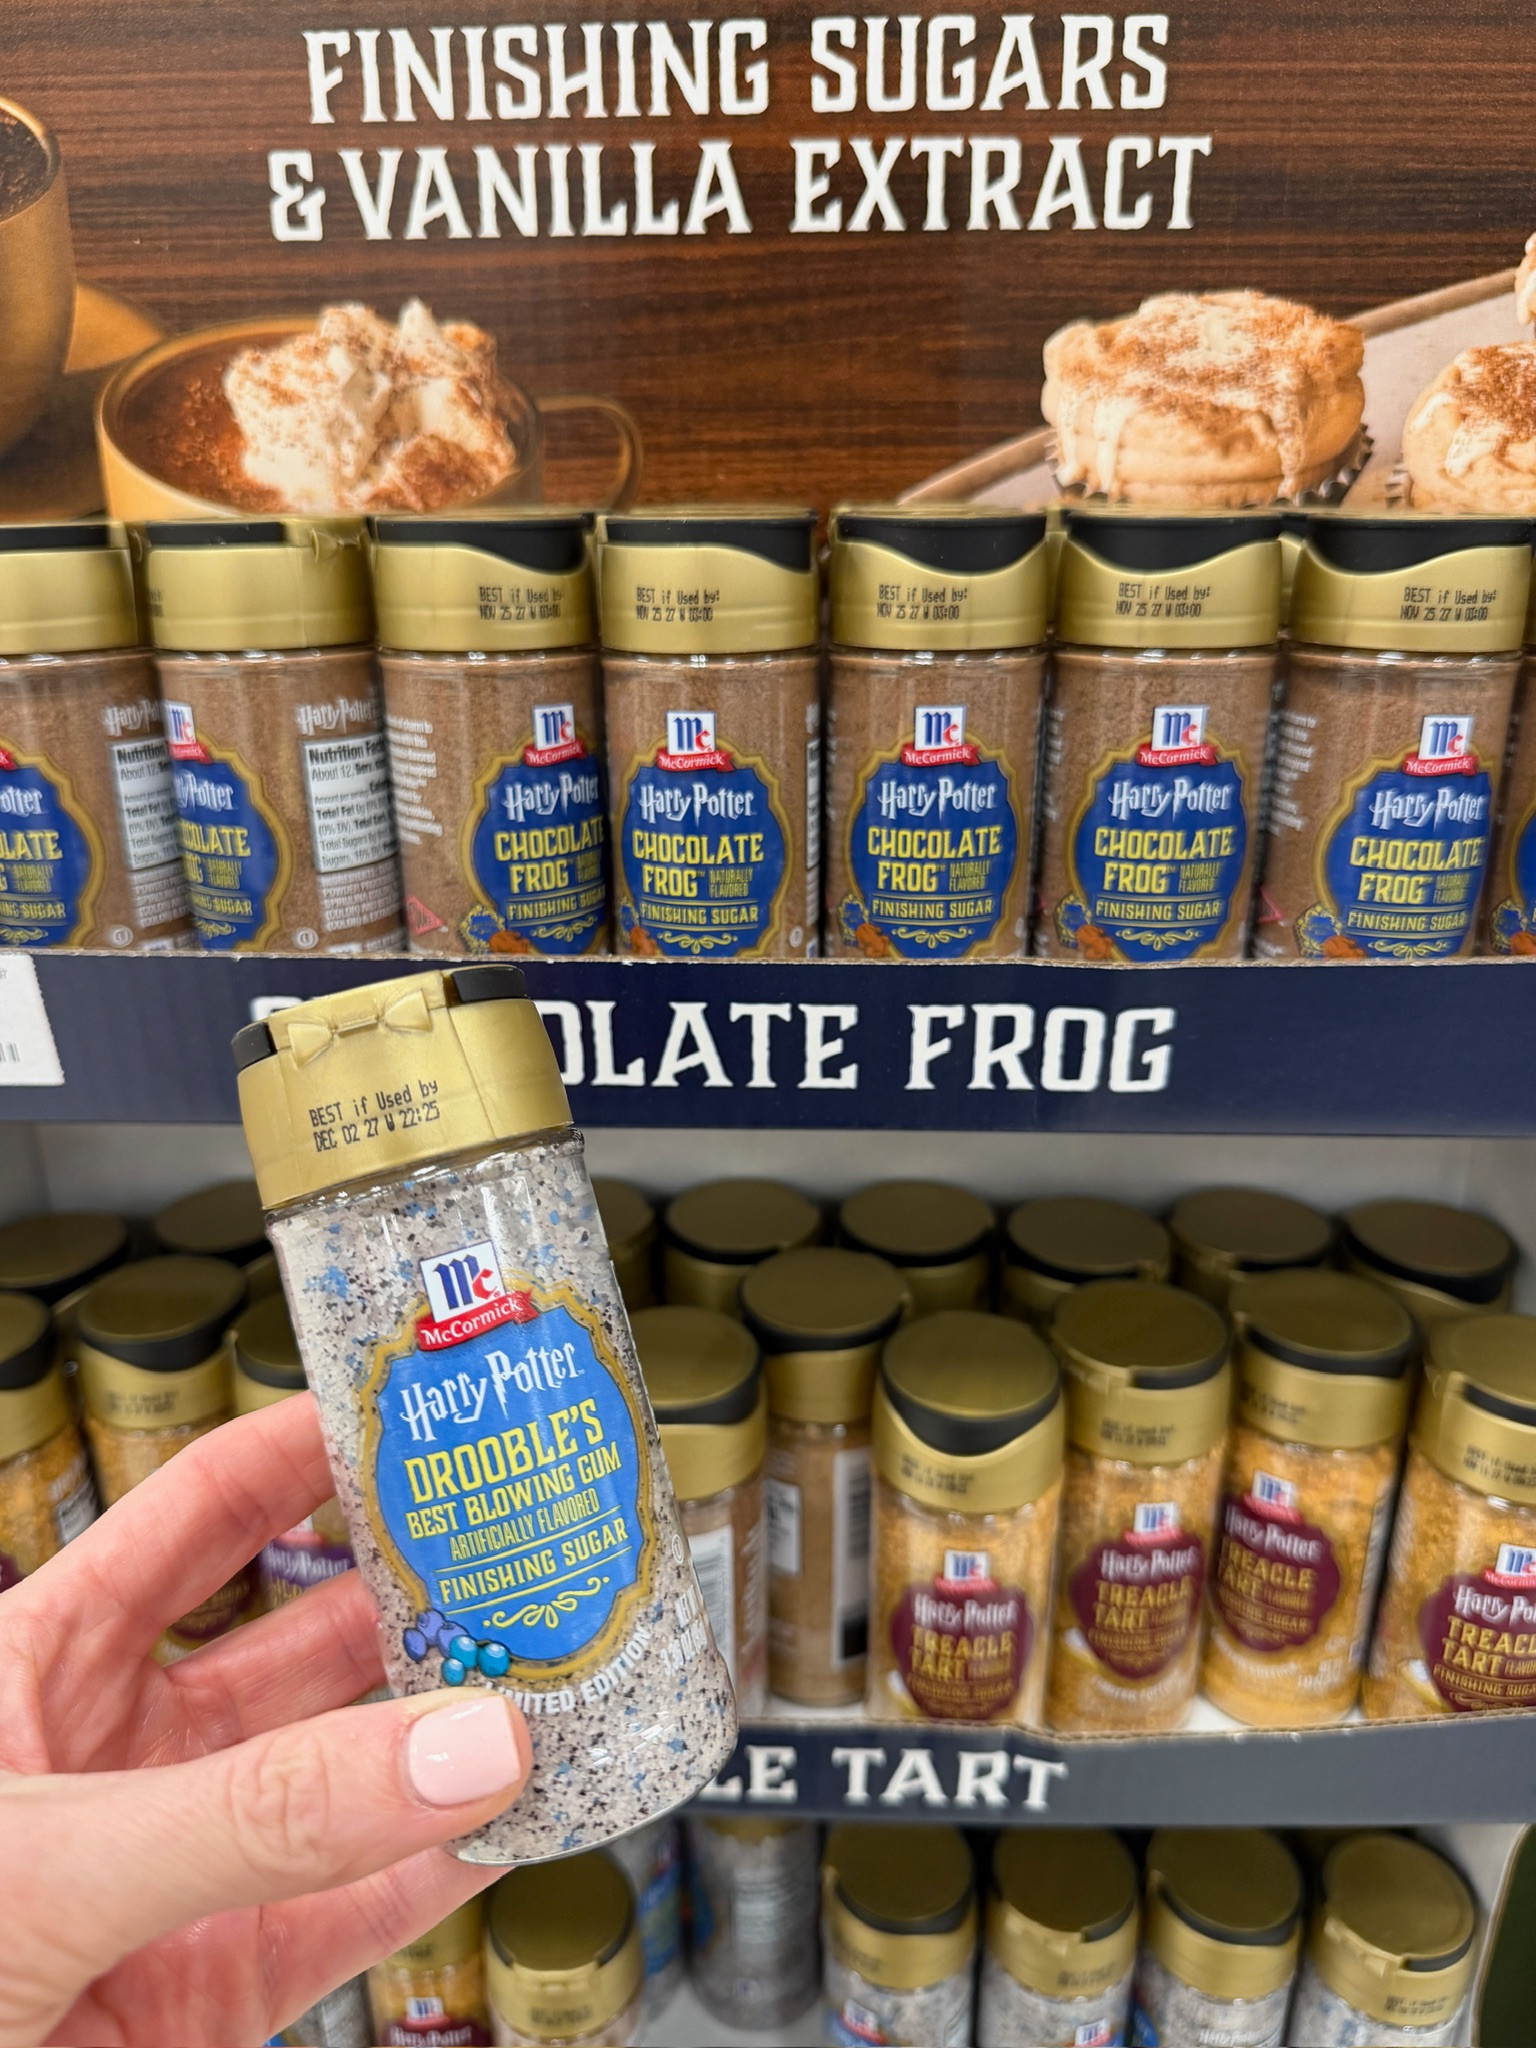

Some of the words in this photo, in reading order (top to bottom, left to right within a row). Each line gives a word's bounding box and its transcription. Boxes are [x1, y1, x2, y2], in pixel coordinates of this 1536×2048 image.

[302, 20, 769, 124] FINISHING
[810, 14, 1171, 114] SUGARS
[268, 149, 325, 242] &
[338, 140, 752, 241] VANILLA
[790, 135, 1214, 233] EXTRACT
[479, 587, 503, 603] BEST
[511, 589, 520, 603] if
[637, 587, 656, 603] BEST
[662, 590, 671, 604] if
[677, 590, 700, 605] Used
[879, 584, 901, 600] BEST
[907, 588, 917, 602] if
[921, 588, 946, 603] Used
[1118, 582, 1142, 599] BEST
[1149, 586, 1160, 600] if
[1165, 586, 1188, 601] Used
[1403, 586, 1431, 603] BEST
[1437, 590, 1449, 604] if
[1455, 590, 1478, 605] Used
[500, 605, 512, 621] 25
[652, 607, 662, 622] 25
[896, 605, 906, 619] 25
[1135, 602, 1148, 617] 25
[1423, 607, 1436, 621] 25
[309, 744, 365, 764] Nutrition
[660, 754, 727, 770] McCormick
[904, 750, 972, 765] McCormick
[1141, 749, 1210, 766] McCormick
[1405, 758, 1469, 774] McCormick
[0, 786, 44, 817] otter
[505, 781, 562, 822] Harry
[639, 785, 692, 824] Harry
[691, 783, 755, 827] Potter
[878, 780, 939, 820] Harry
[937, 776, 998, 821] Potter
[1108, 780, 1174, 820] Harry
[1171, 776, 1233, 821] Potter
[1368, 789, 1434, 829] Harry
[1432, 788, 1487, 830] Potter
[632, 832, 766, 864] CHOCOLATE
[867, 826, 1003, 860] CHOCOLATE
[1094, 825, 1237, 863] CHOCOLATE
[1350, 836, 1486, 871] CHOCOLATE
[507, 896, 578, 922] FINISHING
[641, 904, 707, 925] FINISHING
[711, 905, 760, 926] SUGAR
[872, 900, 944, 921] FINISHING
[948, 900, 994, 921] SUGAR
[1096, 900, 1171, 923] FINISHING
[1176, 899, 1222, 921] SUGAR
[1346, 910, 1426, 932] FINISHING
[1429, 910, 1468, 931] SUGAR
[534, 999, 858, 1088] OLATE
[904, 1002, 1177, 1093] FROG
[309, 1102, 342, 1128] BEST
[353, 1098, 368, 1118] if
[378, 1091, 413, 1112] Used
[418, 1079, 439, 1100] by
[313, 1129, 339, 1153] DEC
[341, 1124, 361, 1144] 02
[363, 1118, 380, 1139] 27
[400, 1101, 441, 1129] 22:25
[421, 1298, 521, 1346] McCormick
[399, 1371, 487, 1443] Harry
[484, 1342, 581, 1422] Potter
[402, 1396, 605, 1504] DROOBLE'S
[406, 1501, 459, 1541] BEST
[463, 1462, 575, 1527] BLOWING
[577, 1440, 622, 1487] GUM
[449, 1518, 534, 1562] ARTIFICIALLY
[536, 1487, 601, 1534] FLAVORED
[438, 1549, 557, 1607] FINISHING
[560, 1516, 630, 1570] SUGAR
[1453, 1584, 1511, 1625] Harry
[584, 1623, 653, 1703] EDITION
[1441, 1637, 1505, 1678] TART
[1504, 1682, 1536, 1698] SUGA
[831, 1746, 1070, 1812] TART
